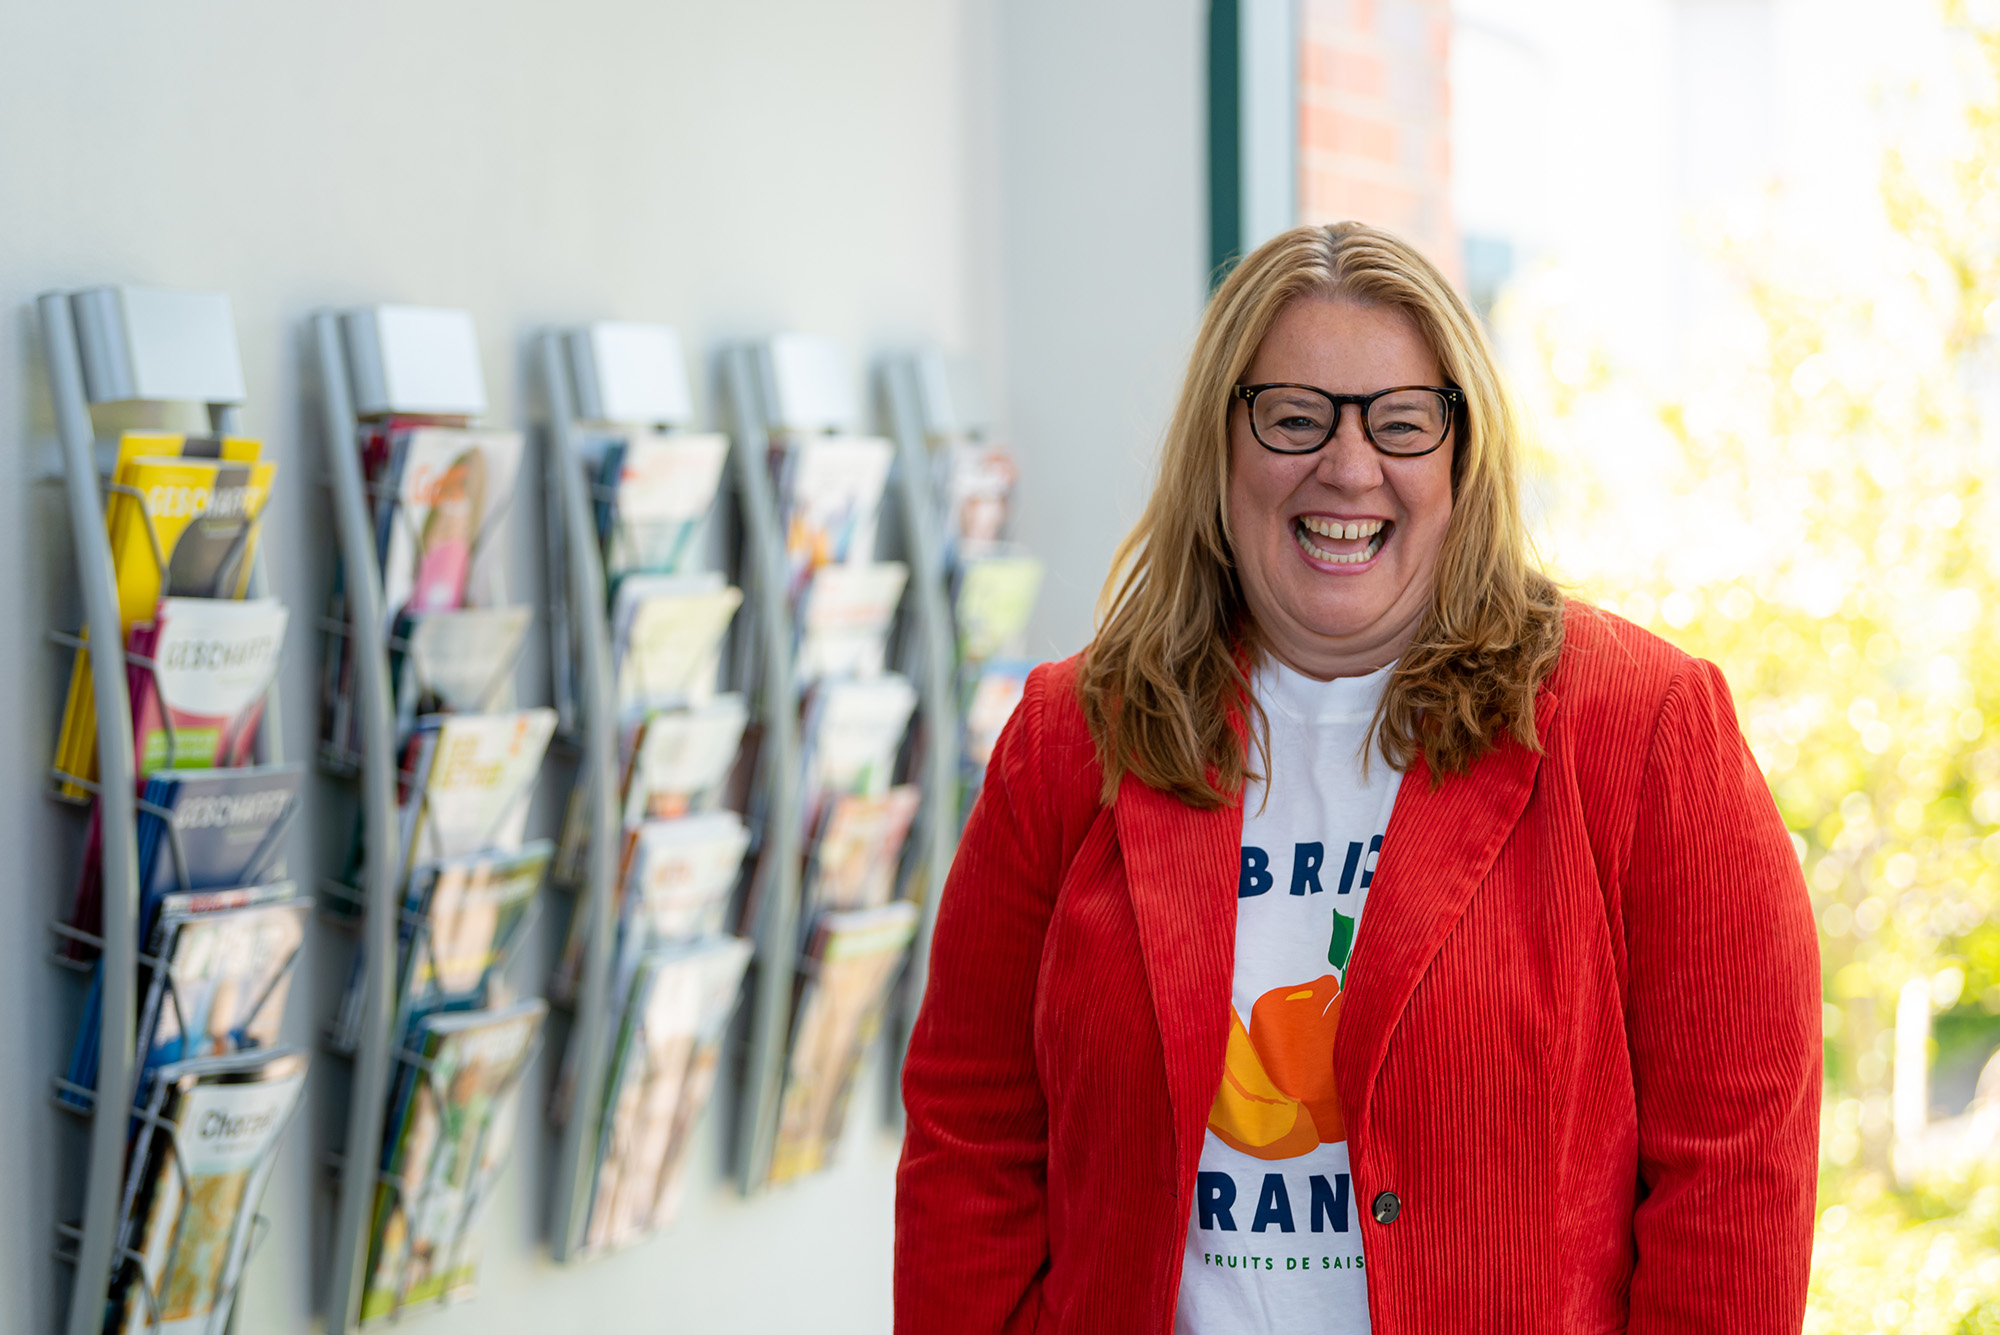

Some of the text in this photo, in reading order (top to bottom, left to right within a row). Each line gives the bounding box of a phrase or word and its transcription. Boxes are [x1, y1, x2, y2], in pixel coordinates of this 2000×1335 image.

[1197, 1171, 1349, 1232] RAN
[1205, 1253, 1364, 1270] FRUITS DE SAIS
